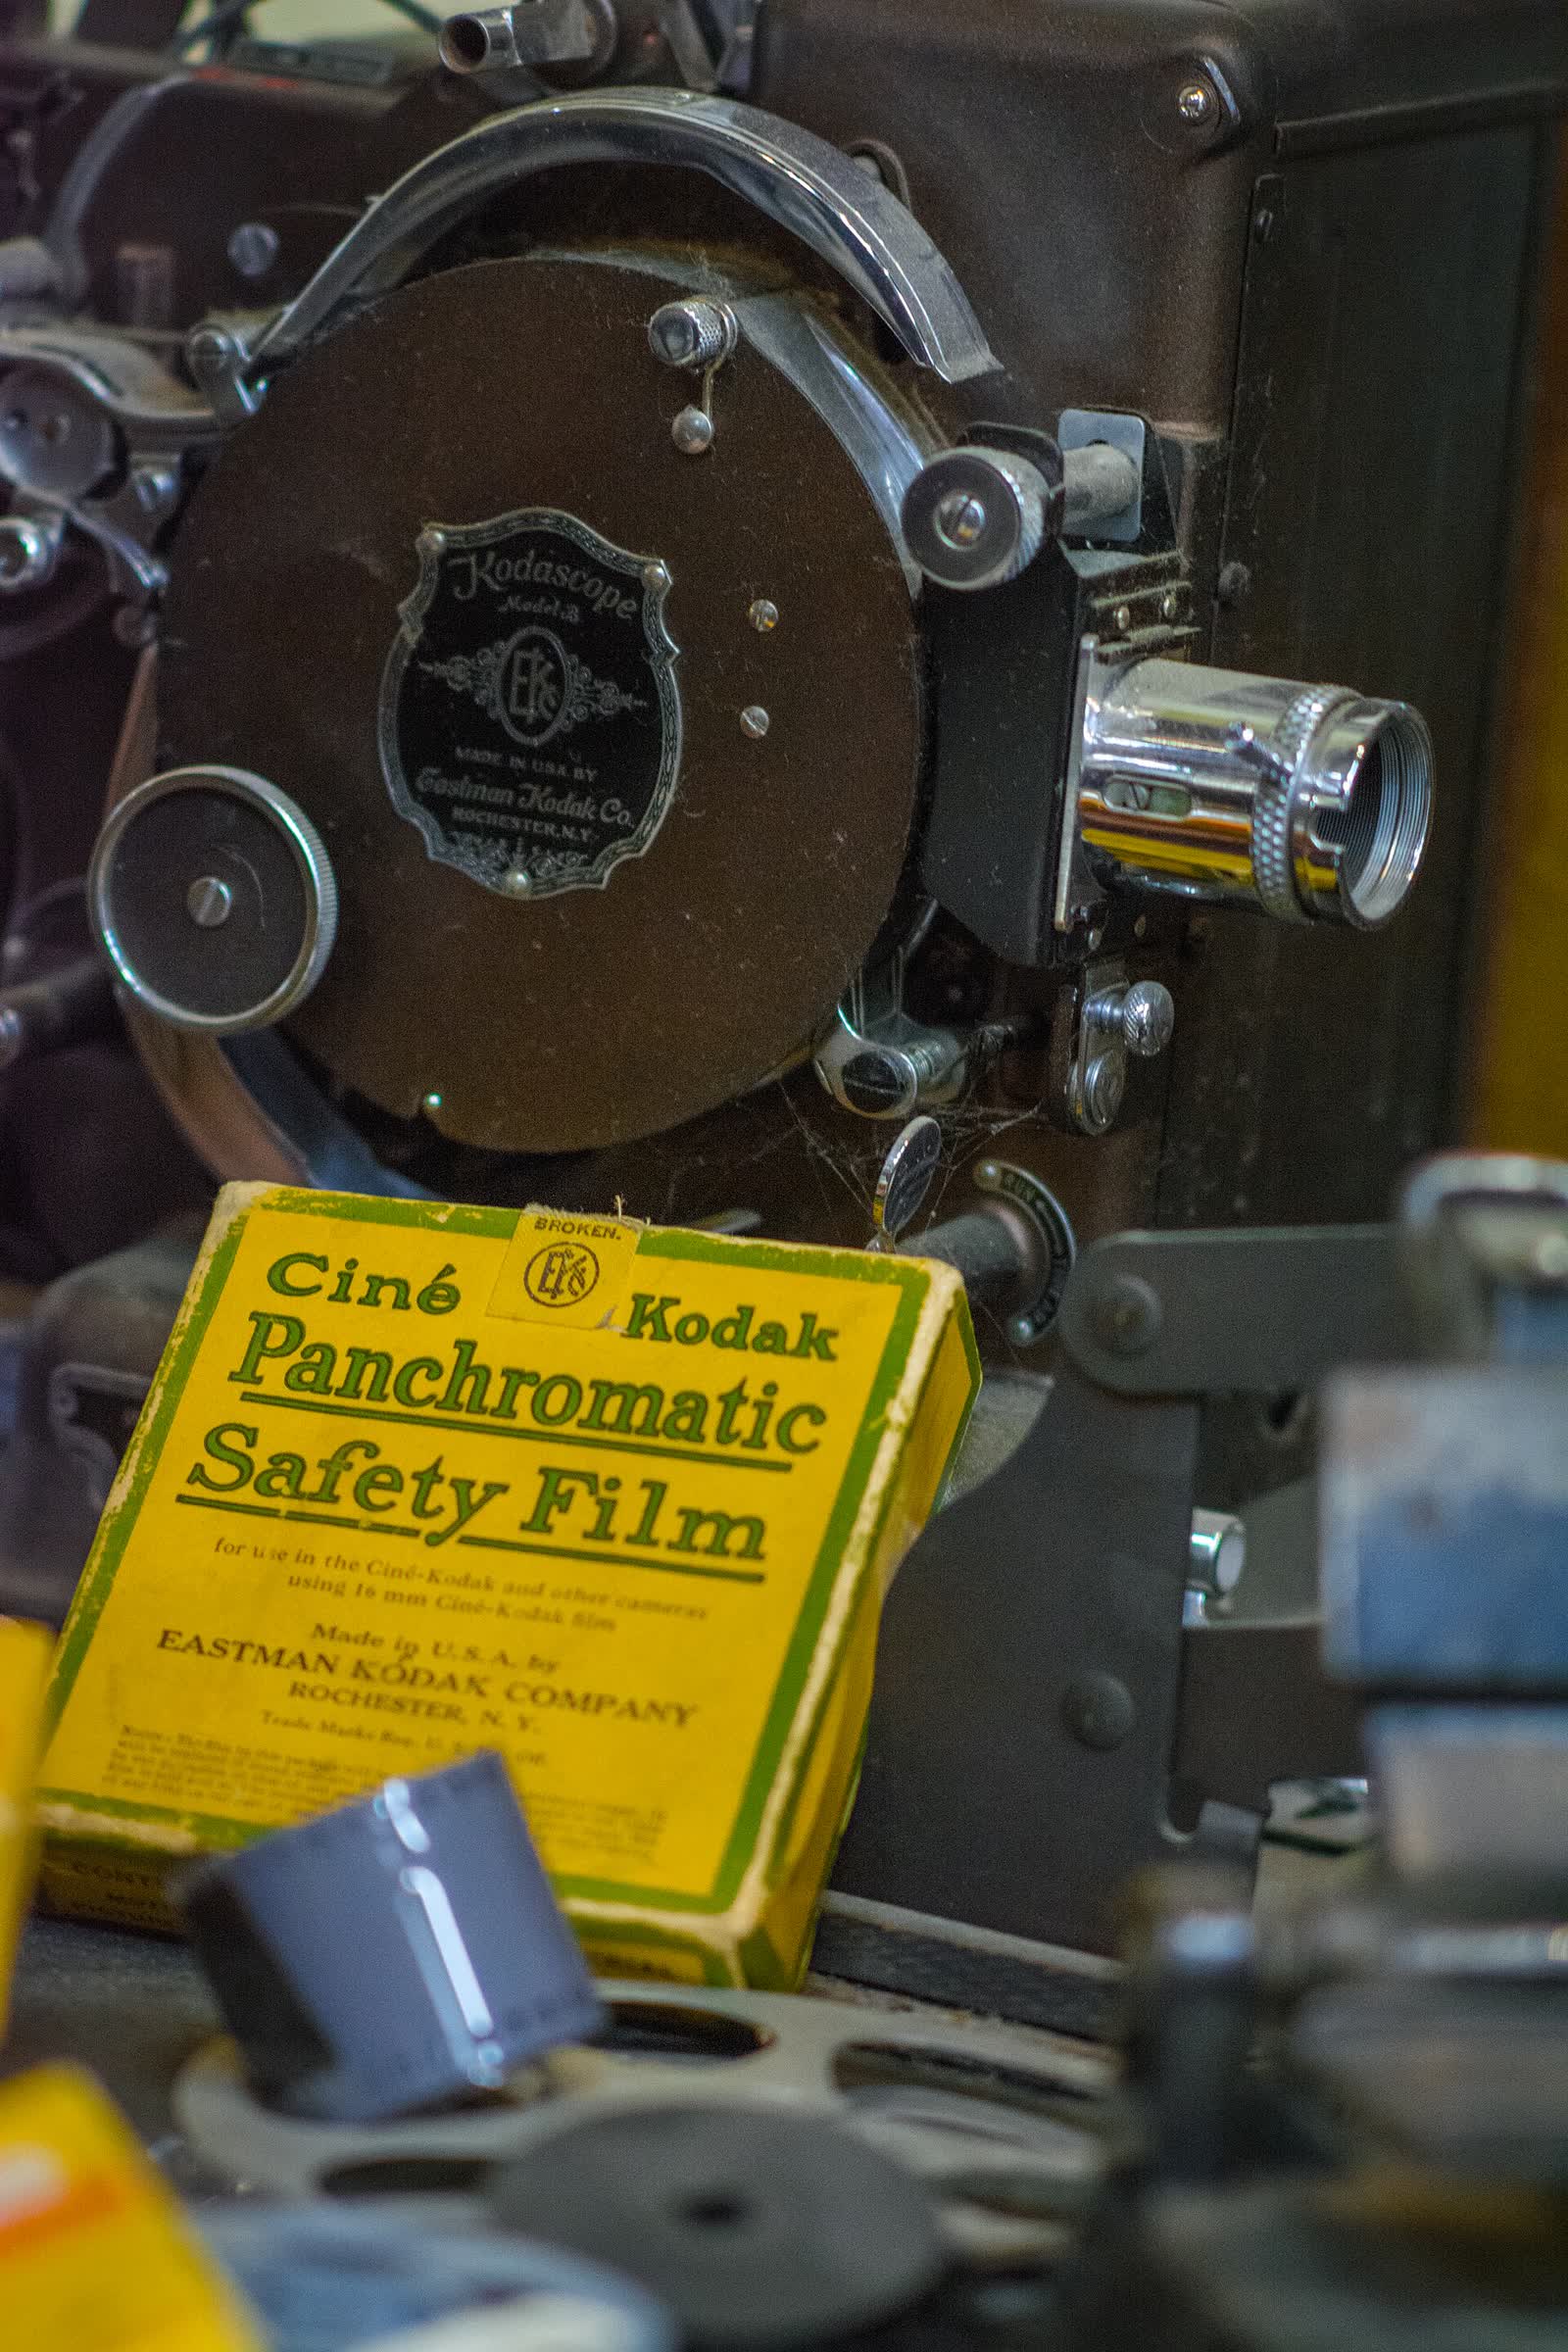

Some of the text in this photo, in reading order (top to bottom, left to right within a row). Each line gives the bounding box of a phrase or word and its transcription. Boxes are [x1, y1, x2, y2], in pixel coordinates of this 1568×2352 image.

[446, 549, 639, 620] Kodascope
[498, 594, 560, 615] Model
[415, 764, 636, 829] Eastman Kodak Co.
[455, 745, 503, 768] MADE
[509, 755, 528, 771] IN
[573, 764, 599, 784] BY
[533, 1217, 622, 1241] BROKEN.
[266, 1251, 840, 1363] Ciné Kodak
[227, 1310, 829, 1455] Panchromatic
[186, 1422, 769, 1561] Safety Film
[213, 1537, 247, 1555] for
[294, 1547, 317, 1566] in
[324, 1554, 361, 1572] the
[502, 1581, 548, 1598] and
[549, 1586, 612, 1606] other
[287, 1574, 347, 1598] using
[355, 1582, 376, 1600] 16
[383, 1590, 428, 1608] mm
[570, 1612, 618, 1633] film
[156, 1627, 699, 1729] EASTMAN KODAK COMPANY
[311, 1622, 386, 1648] Made
[393, 1629, 420, 1654] in
[527, 1653, 561, 1675] by
